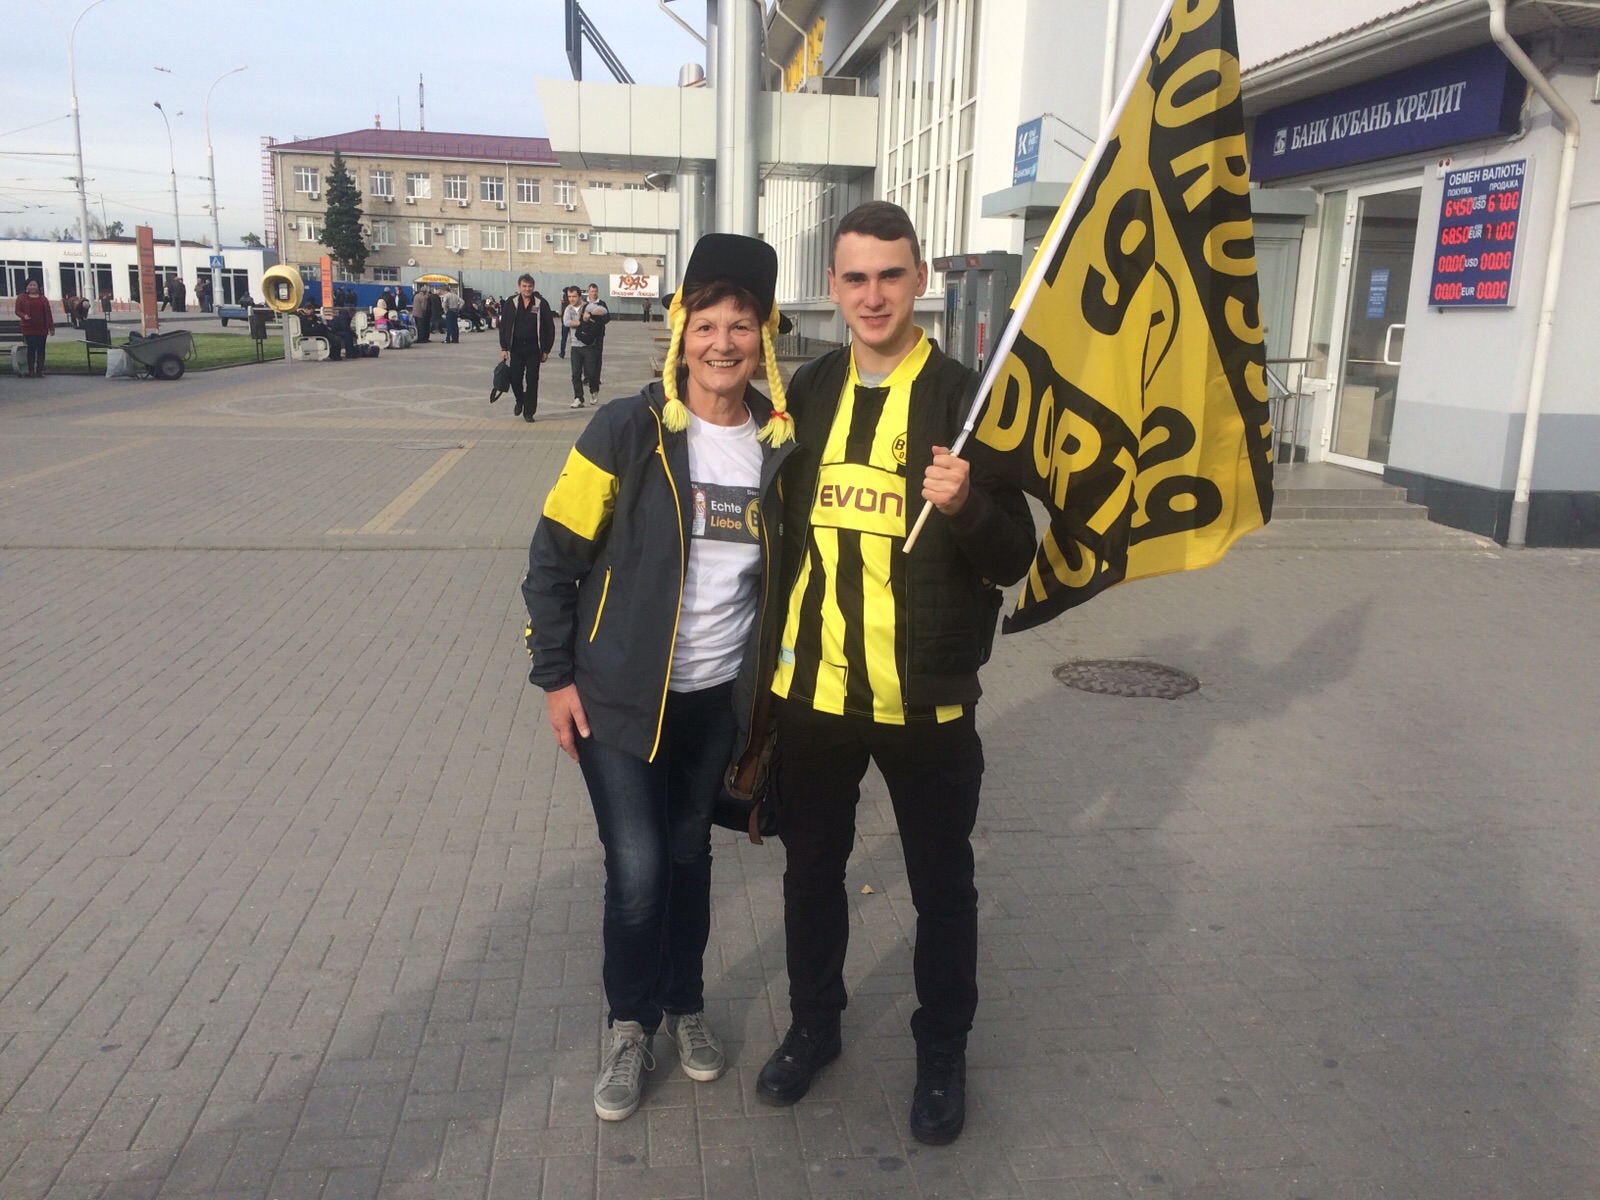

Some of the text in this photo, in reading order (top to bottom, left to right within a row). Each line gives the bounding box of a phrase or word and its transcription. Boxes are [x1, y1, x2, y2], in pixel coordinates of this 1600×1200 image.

[1290, 81, 1467, 150] БАНК КУБАНЬ КРЕДИТ
[1448, 162, 1526, 186] ОБМЕН ВАЛЮТЫ
[1447, 186, 1473, 197] ПОКУПКА
[1489, 179, 1519, 191] ПРОДАЖА
[1472, 200, 1487, 210] USD
[1468, 229, 1483, 240] EUR
[1465, 258, 1479, 268] USD
[1461, 287, 1475, 297] EUR
[711, 500, 742, 514] Echte
[710, 515, 743, 530] Liebe
